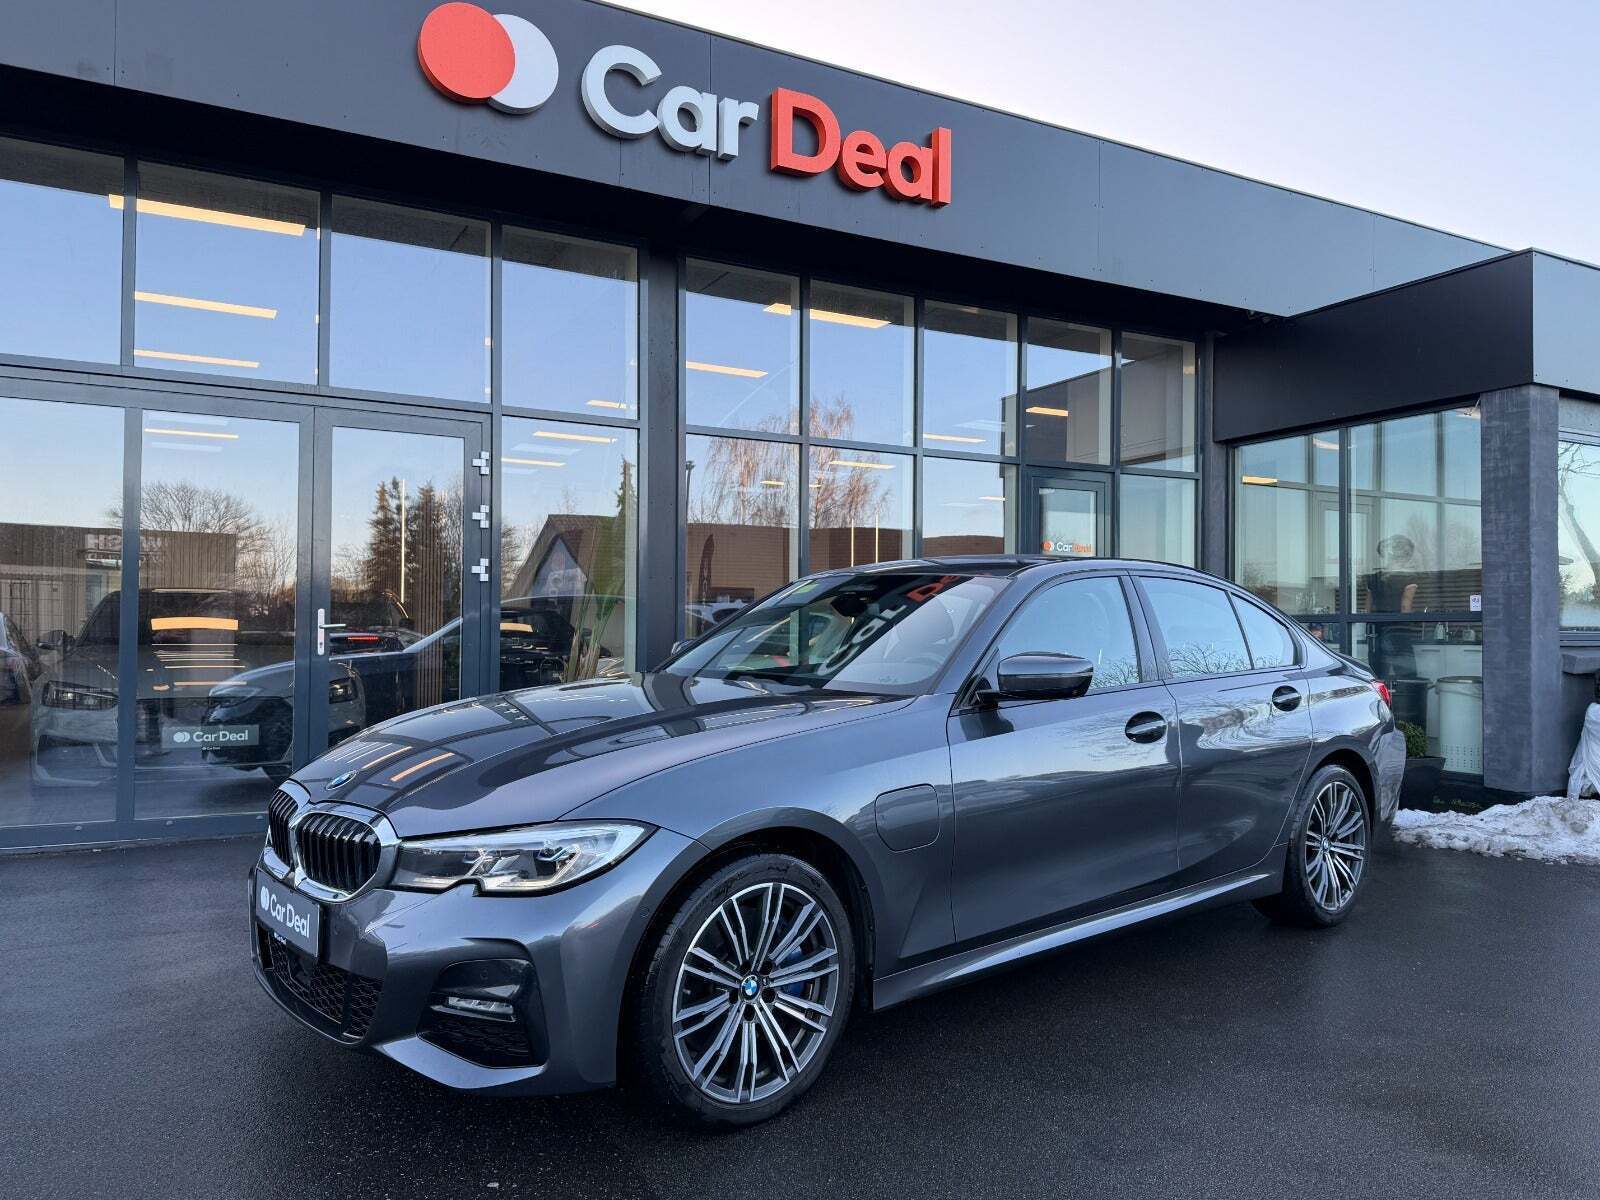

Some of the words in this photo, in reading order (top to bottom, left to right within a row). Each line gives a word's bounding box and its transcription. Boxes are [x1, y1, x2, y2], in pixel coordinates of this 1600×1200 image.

[582, 45, 759, 161] Car
[770, 87, 951, 207] Deal
[1057, 542, 1072, 552] Car
[193, 731, 217, 742] Car
[220, 730, 248, 741] Deal
[270, 894, 286, 922] Car
[286, 904, 310, 938] Deal
